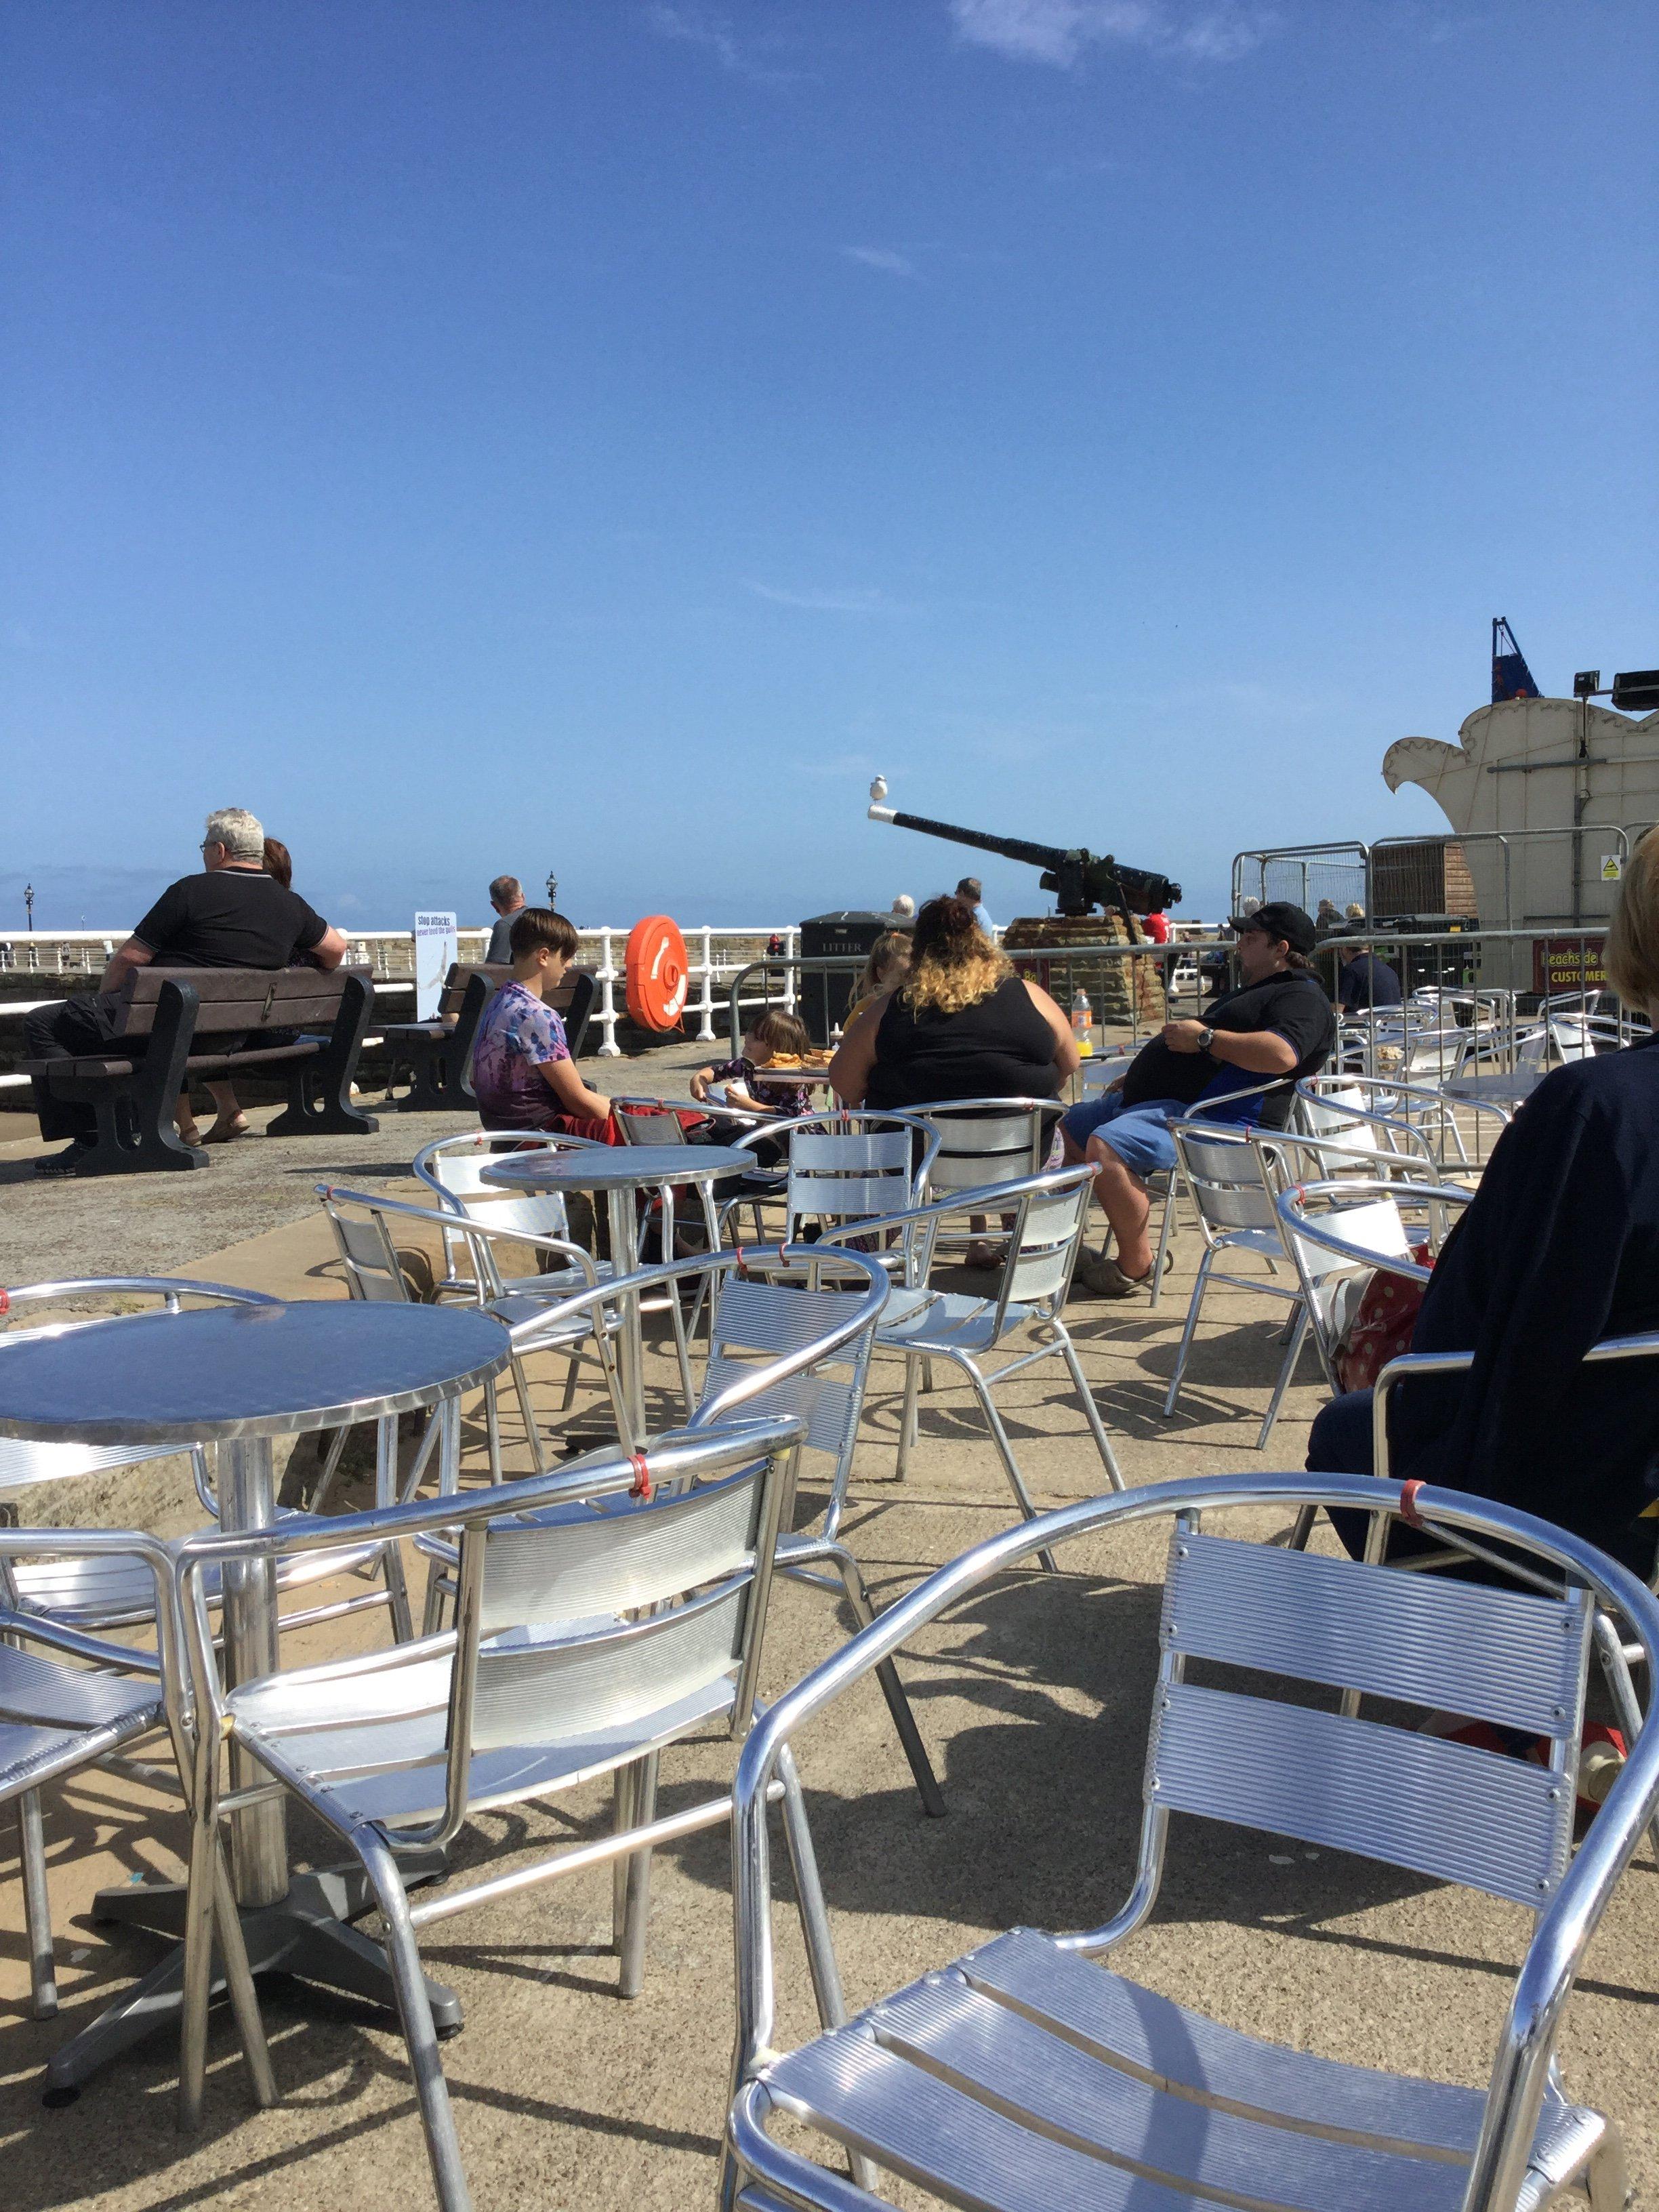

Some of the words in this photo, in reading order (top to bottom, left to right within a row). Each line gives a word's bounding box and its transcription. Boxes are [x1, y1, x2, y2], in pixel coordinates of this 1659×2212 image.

[417, 916, 430, 926] stop
[430, 916, 450, 926] attacks
[822, 943, 862, 952] LITTER
[1541, 949, 1598, 966] eachsde
